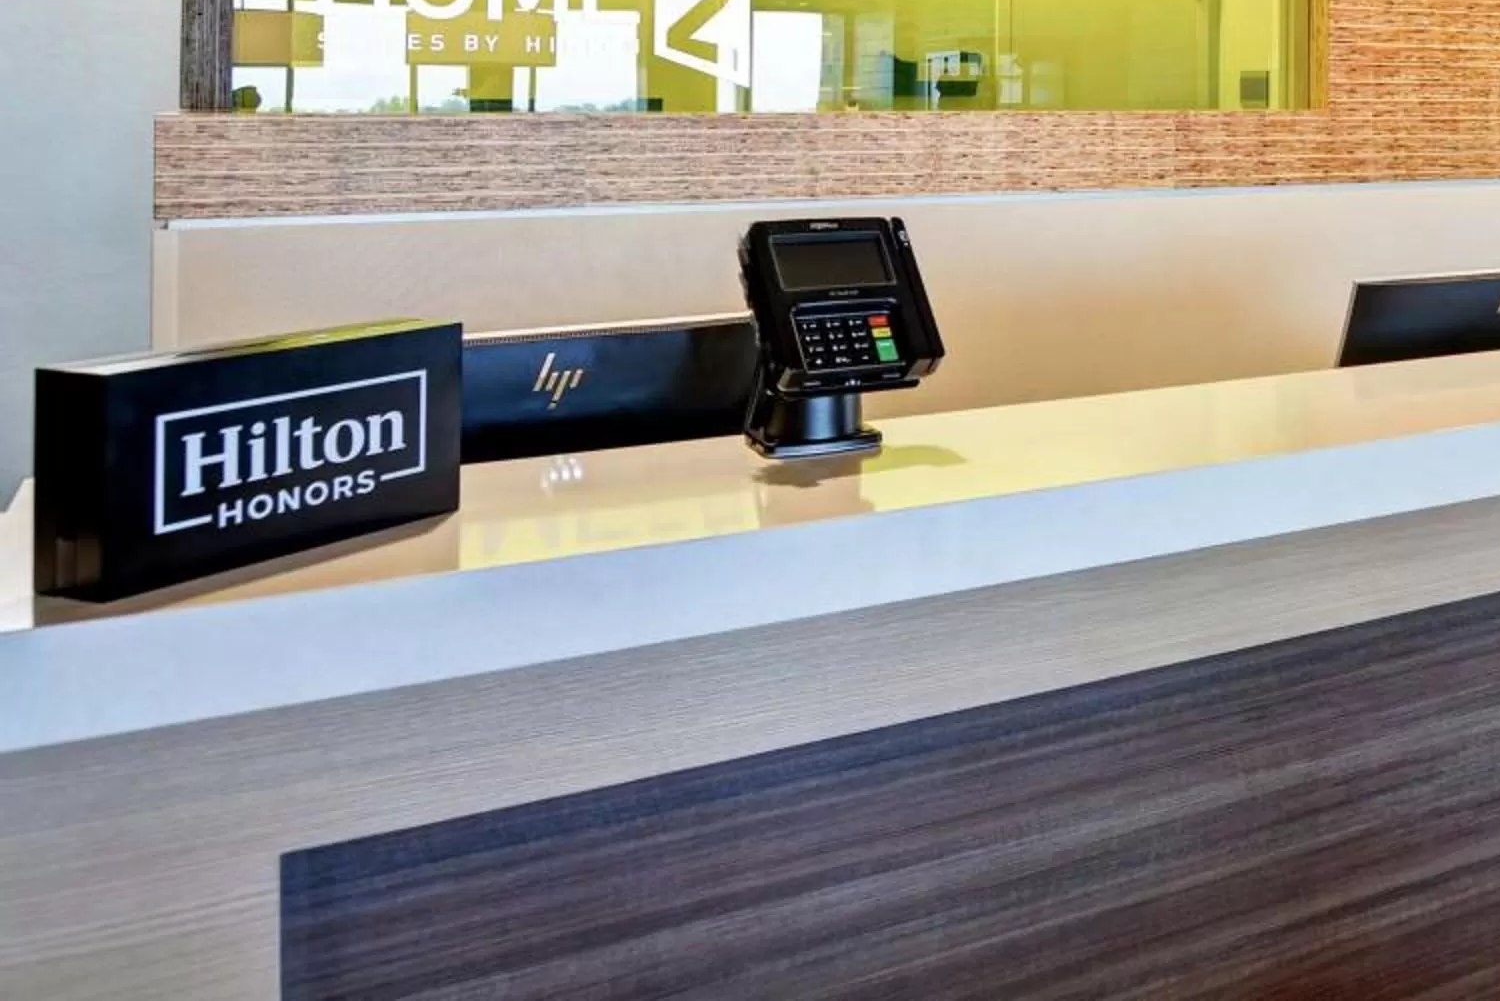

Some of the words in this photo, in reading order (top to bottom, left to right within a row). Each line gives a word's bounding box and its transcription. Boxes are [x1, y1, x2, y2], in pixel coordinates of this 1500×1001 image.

[464, 34, 499, 51] BY
[532, 352, 584, 410] hp
[180, 410, 406, 497] Hilton
[218, 470, 376, 529] HONORS
